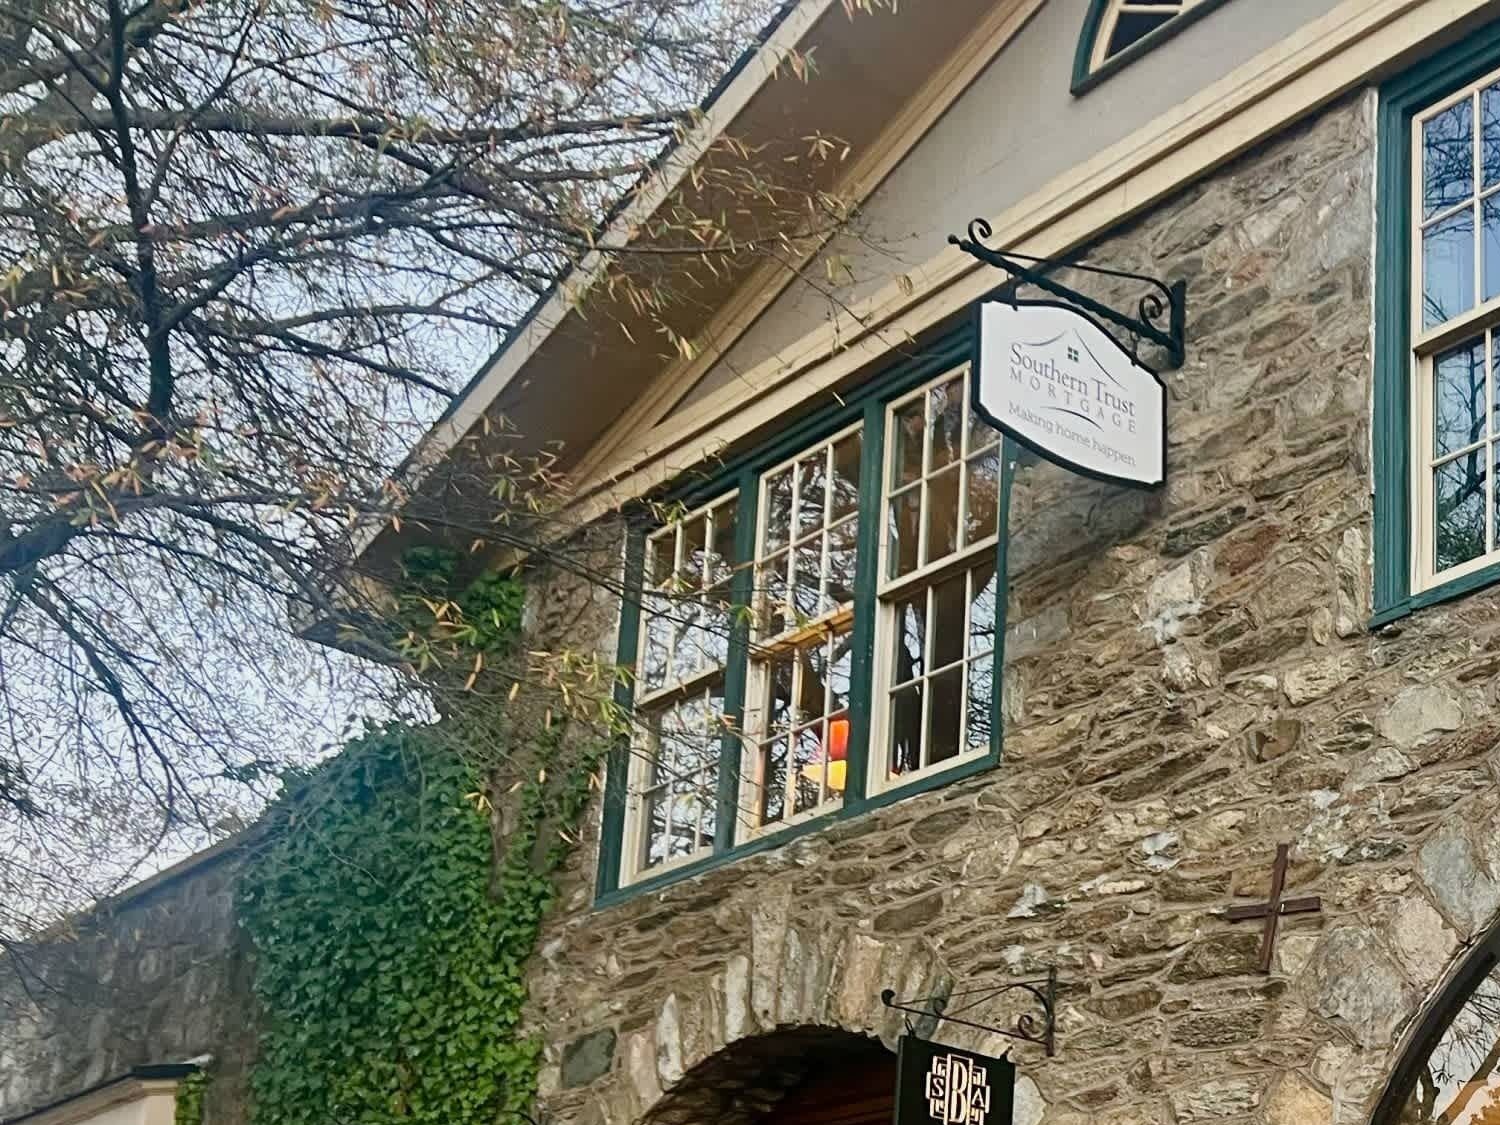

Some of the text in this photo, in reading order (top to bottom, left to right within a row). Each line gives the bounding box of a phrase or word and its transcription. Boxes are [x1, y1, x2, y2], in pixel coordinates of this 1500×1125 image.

[1009, 366, 1136, 433] MORTGAGE
[1010, 342, 1136, 417] Southern Trust
[1009, 400, 1054, 436] Making
[1055, 418, 1091, 449] home
